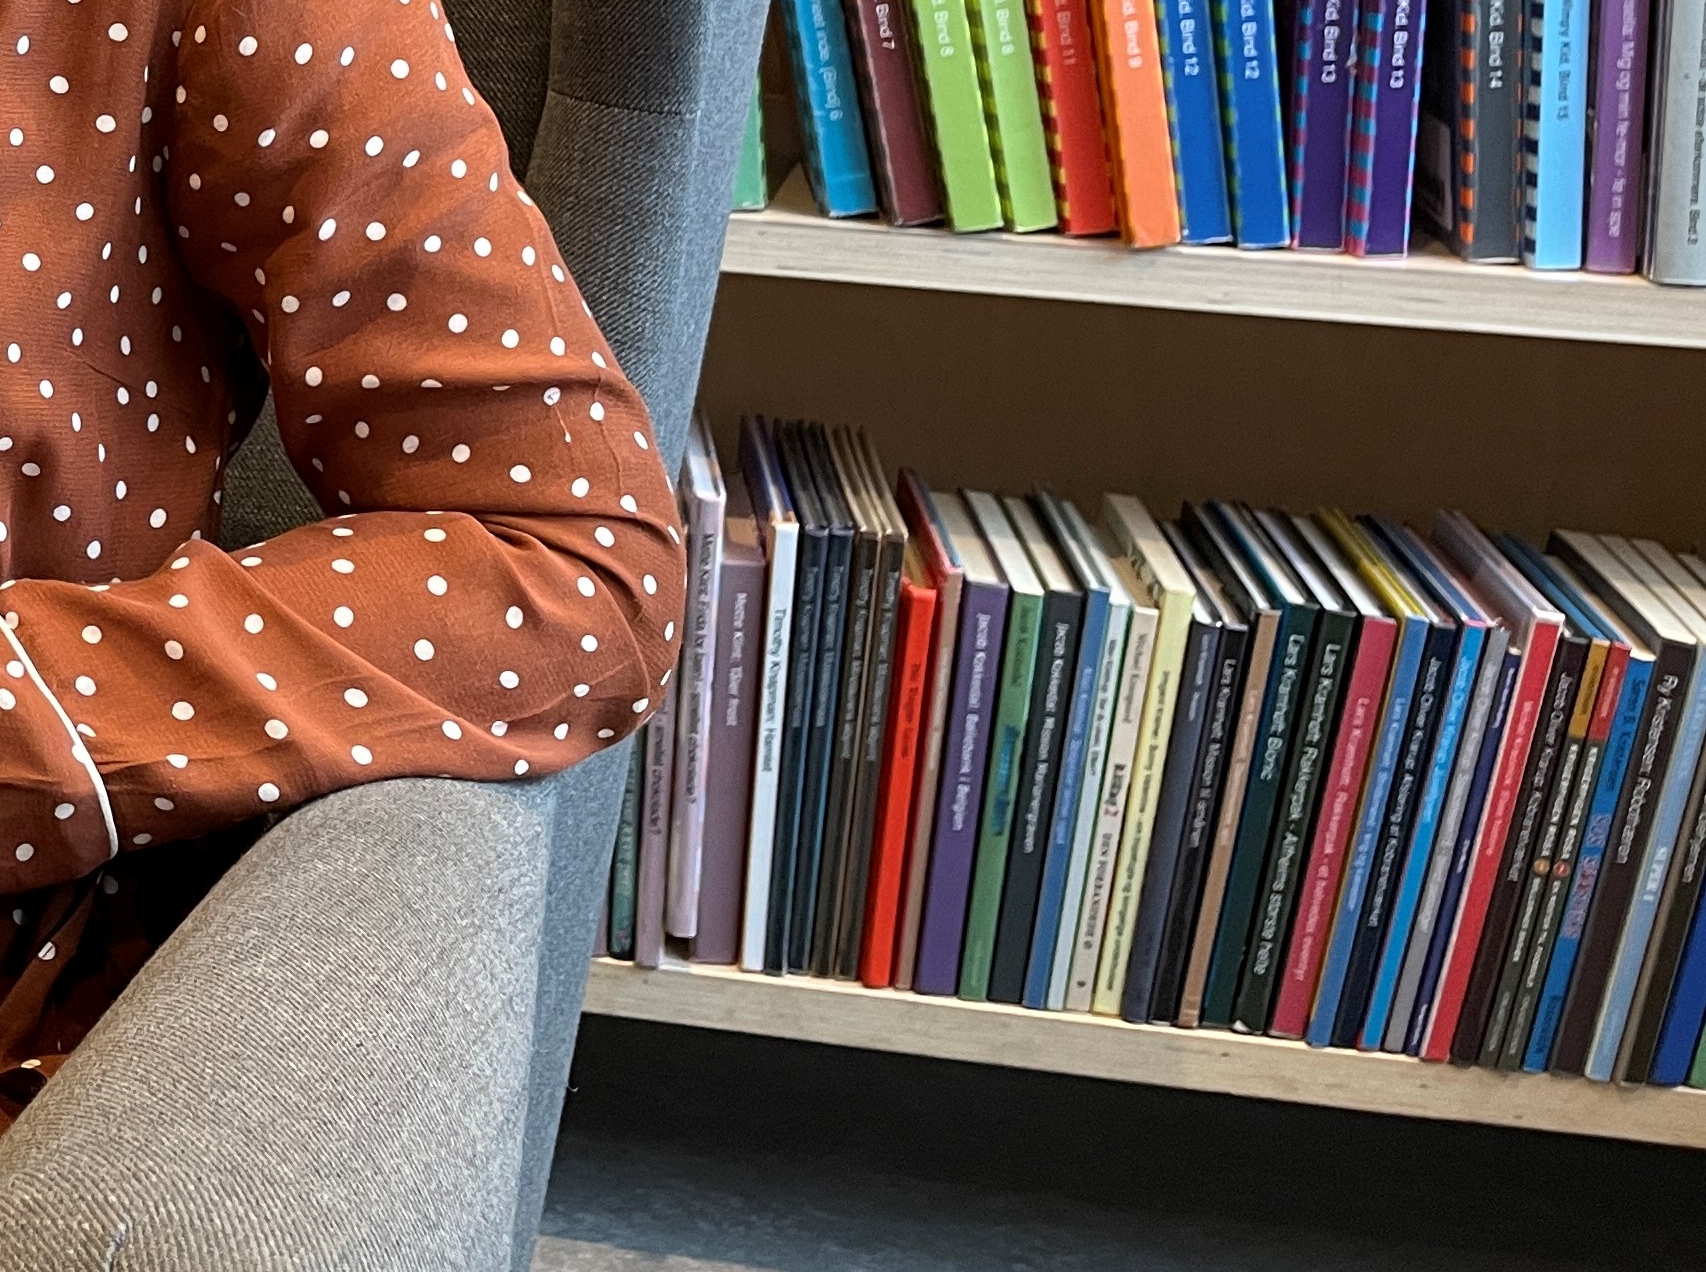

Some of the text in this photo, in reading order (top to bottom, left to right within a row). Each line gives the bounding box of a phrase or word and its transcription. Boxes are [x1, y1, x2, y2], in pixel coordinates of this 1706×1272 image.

[876, 3, 893, 38] Bind
[996, 8, 1012, 43] Bind
[1124, 20, 1141, 55] Bind
[1179, 18, 1197, 55] Bind
[882, 38, 895, 50] 7
[1242, 21, 1258, 58] Bind
[1322, 25, 1340, 61] Bind
[1392, 30, 1408, 66] Bind
[1488, 31, 1504, 66] Bind
[1184, 57, 1199, 76] 12
[1244, 60, 1260, 79] 12
[1321, 64, 1336, 84] 13
[1390, 69, 1405, 88] 13
[1490, 70, 1503, 88] 14
